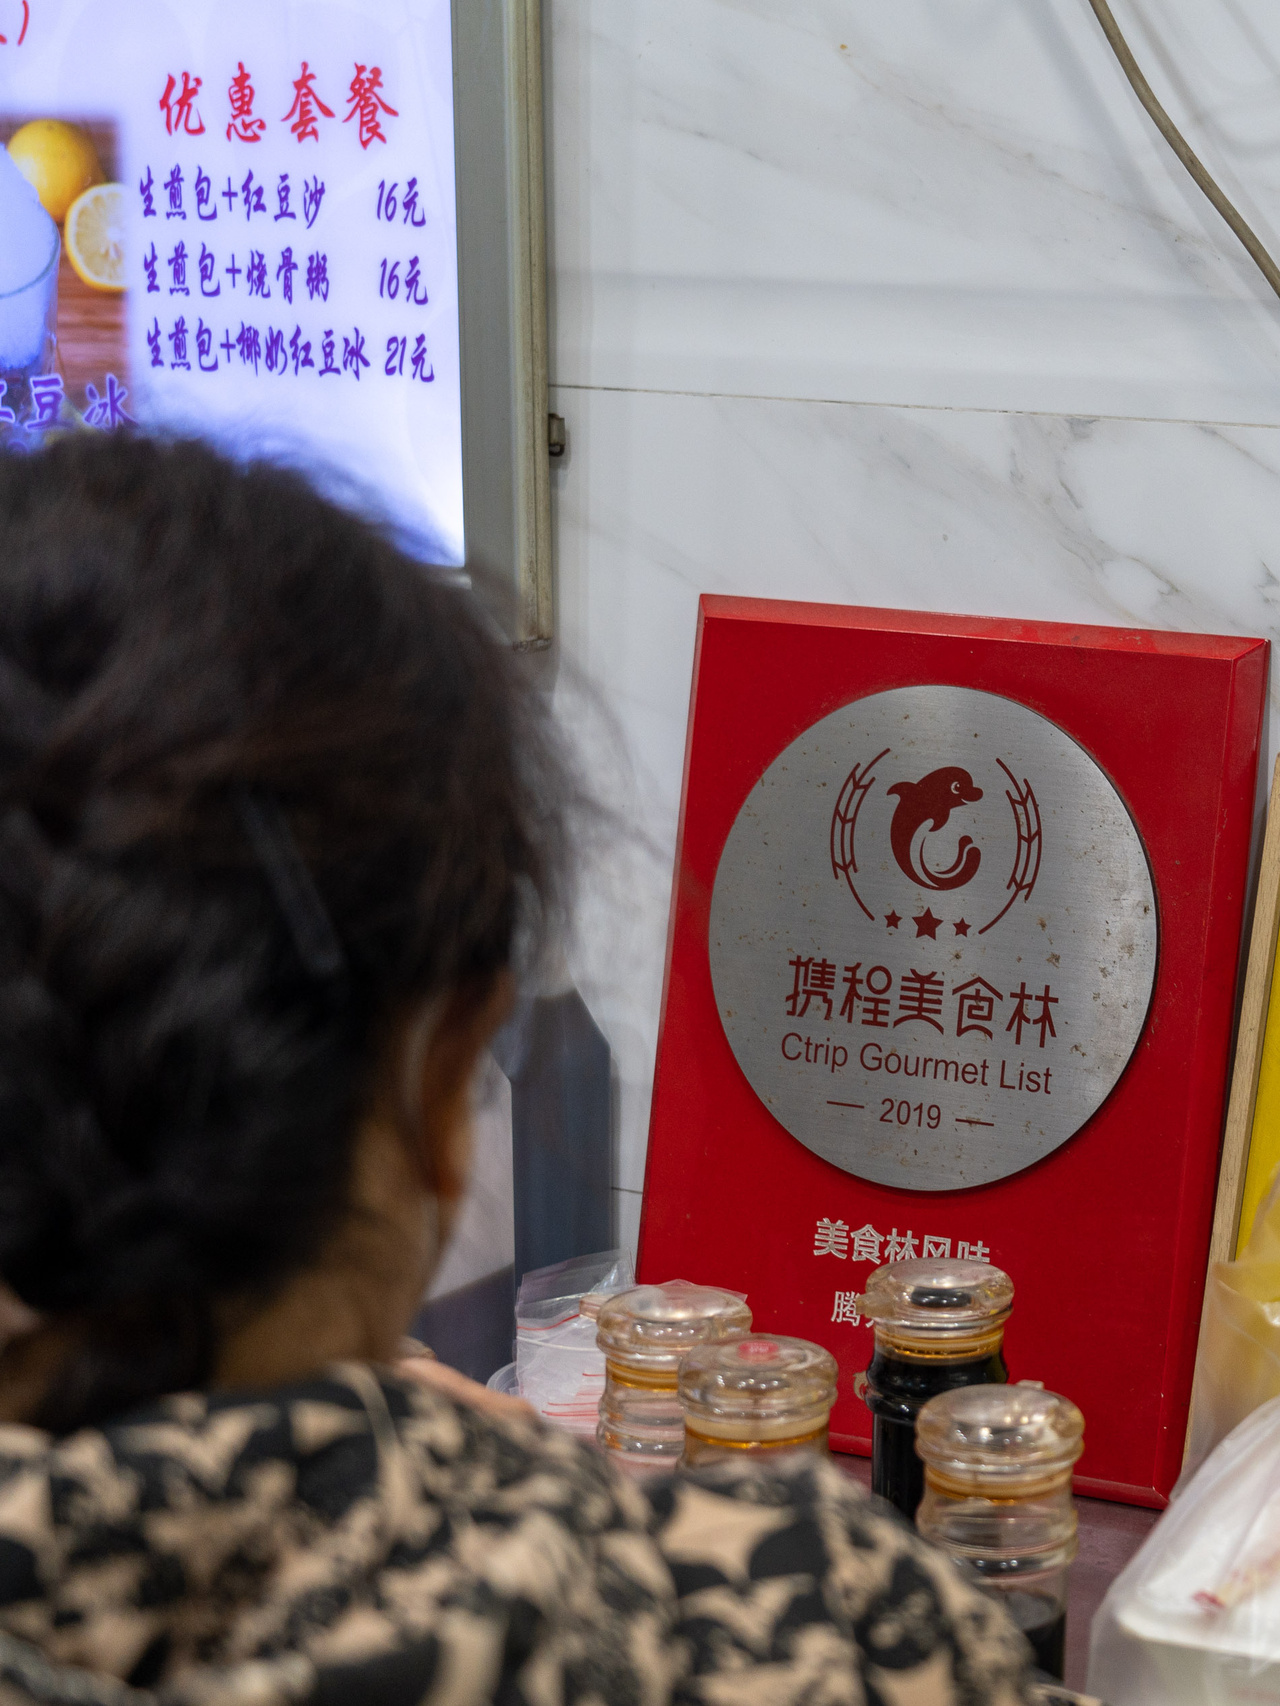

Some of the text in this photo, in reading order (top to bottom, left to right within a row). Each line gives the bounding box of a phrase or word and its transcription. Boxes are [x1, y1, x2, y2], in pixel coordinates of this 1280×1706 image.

[159, 62, 400, 150] 优惠套餐
[140, 164, 427, 229] 生煎包+红豆沙 16元
[379, 256, 429, 305] 16元
[384, 333, 435, 383] 21元
[785, 955, 1059, 1048] 携程美食林
[781, 1032, 1052, 1095] Ctrip Gourmet List
